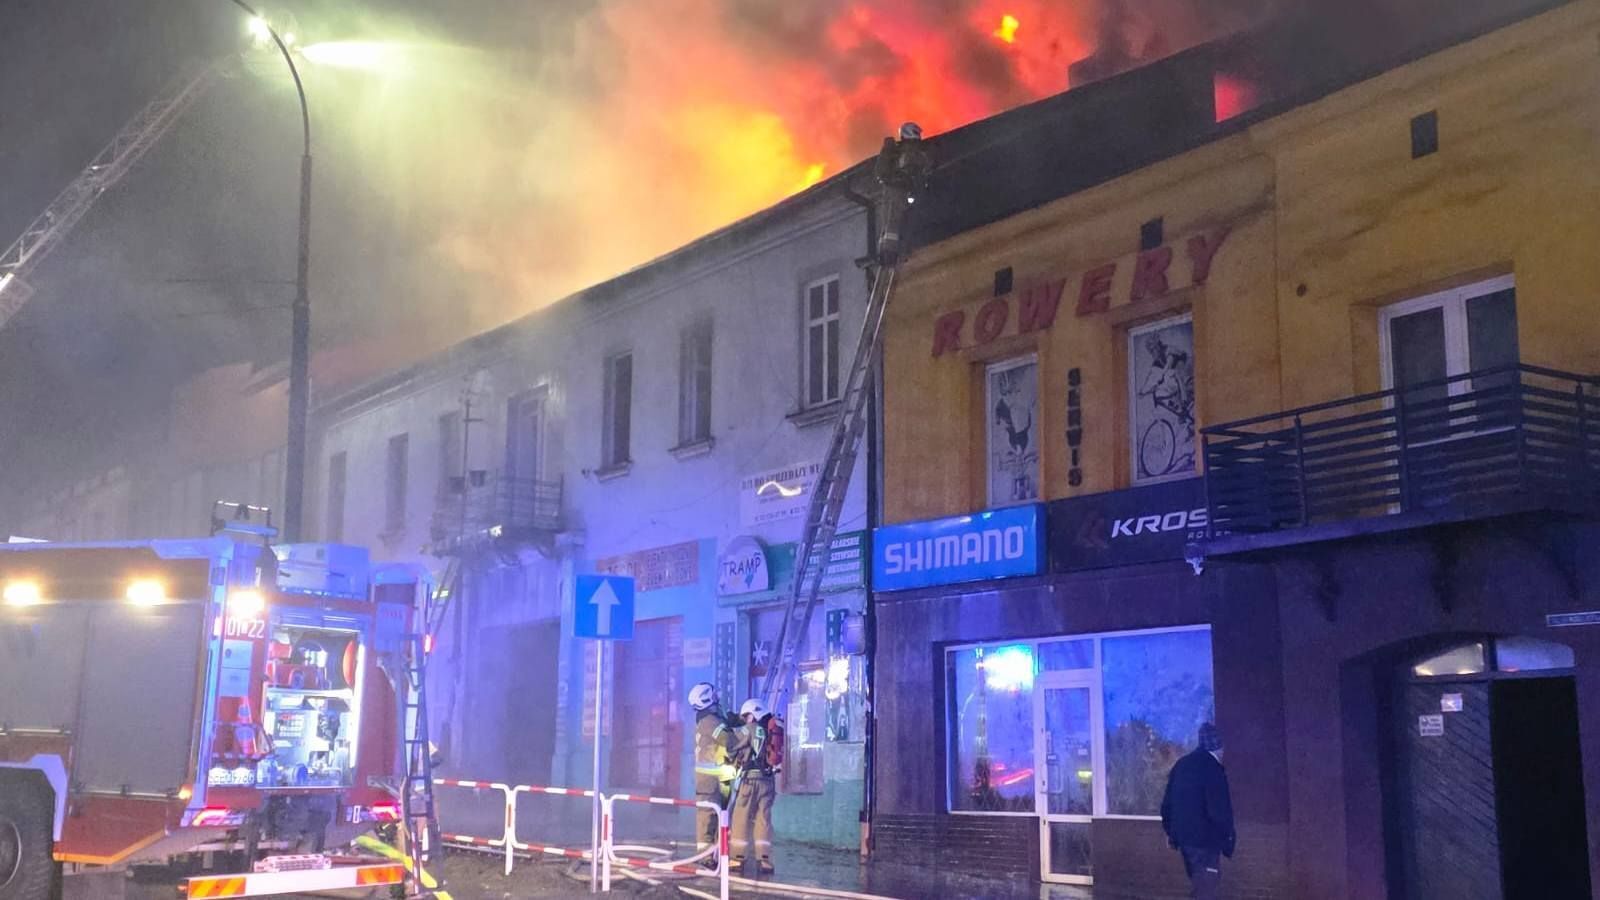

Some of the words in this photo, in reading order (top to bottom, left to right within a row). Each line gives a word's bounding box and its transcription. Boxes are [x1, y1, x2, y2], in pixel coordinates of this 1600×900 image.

[931, 226, 1232, 358] ROWERY
[1066, 367, 1082, 487] SERWIS
[723, 555, 761, 578] TRAMP
[884, 525, 1024, 575] SHIMANO
